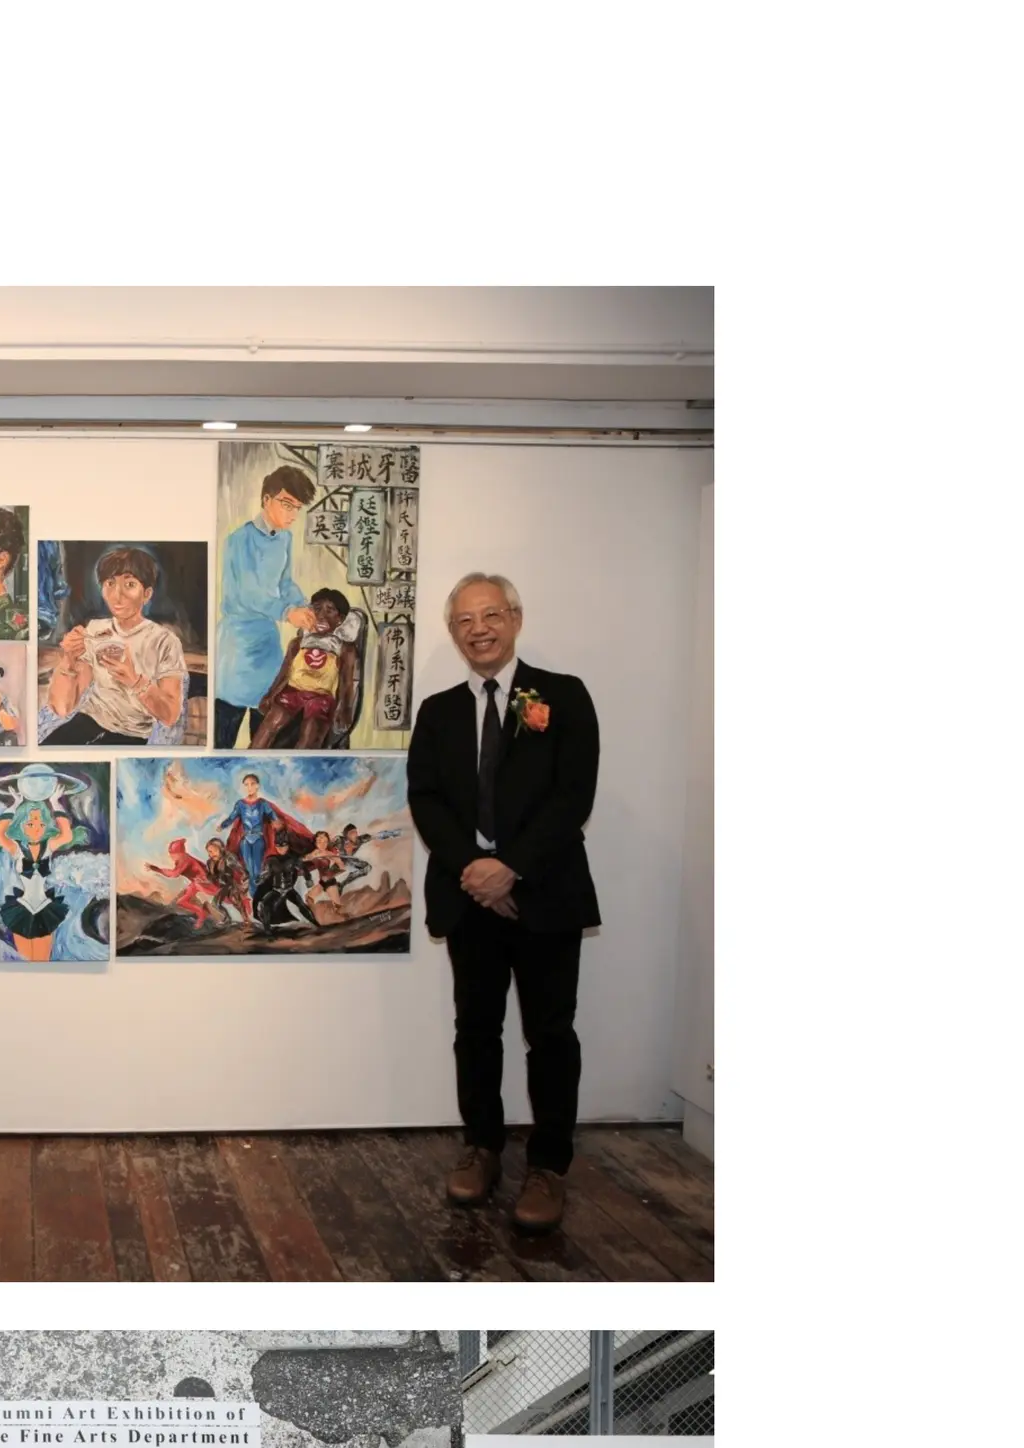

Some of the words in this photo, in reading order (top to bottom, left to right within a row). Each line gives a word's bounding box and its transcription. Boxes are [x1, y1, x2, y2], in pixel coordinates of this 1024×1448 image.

[63, 1407, 97, 1420] Art
[107, 1406, 217, 1421] Exhibition
[226, 1407, 247, 1421] of
[20, 1429, 64, 1443] Fine
[74, 1430, 118, 1444] Arts
[128, 1429, 250, 1447] Department
